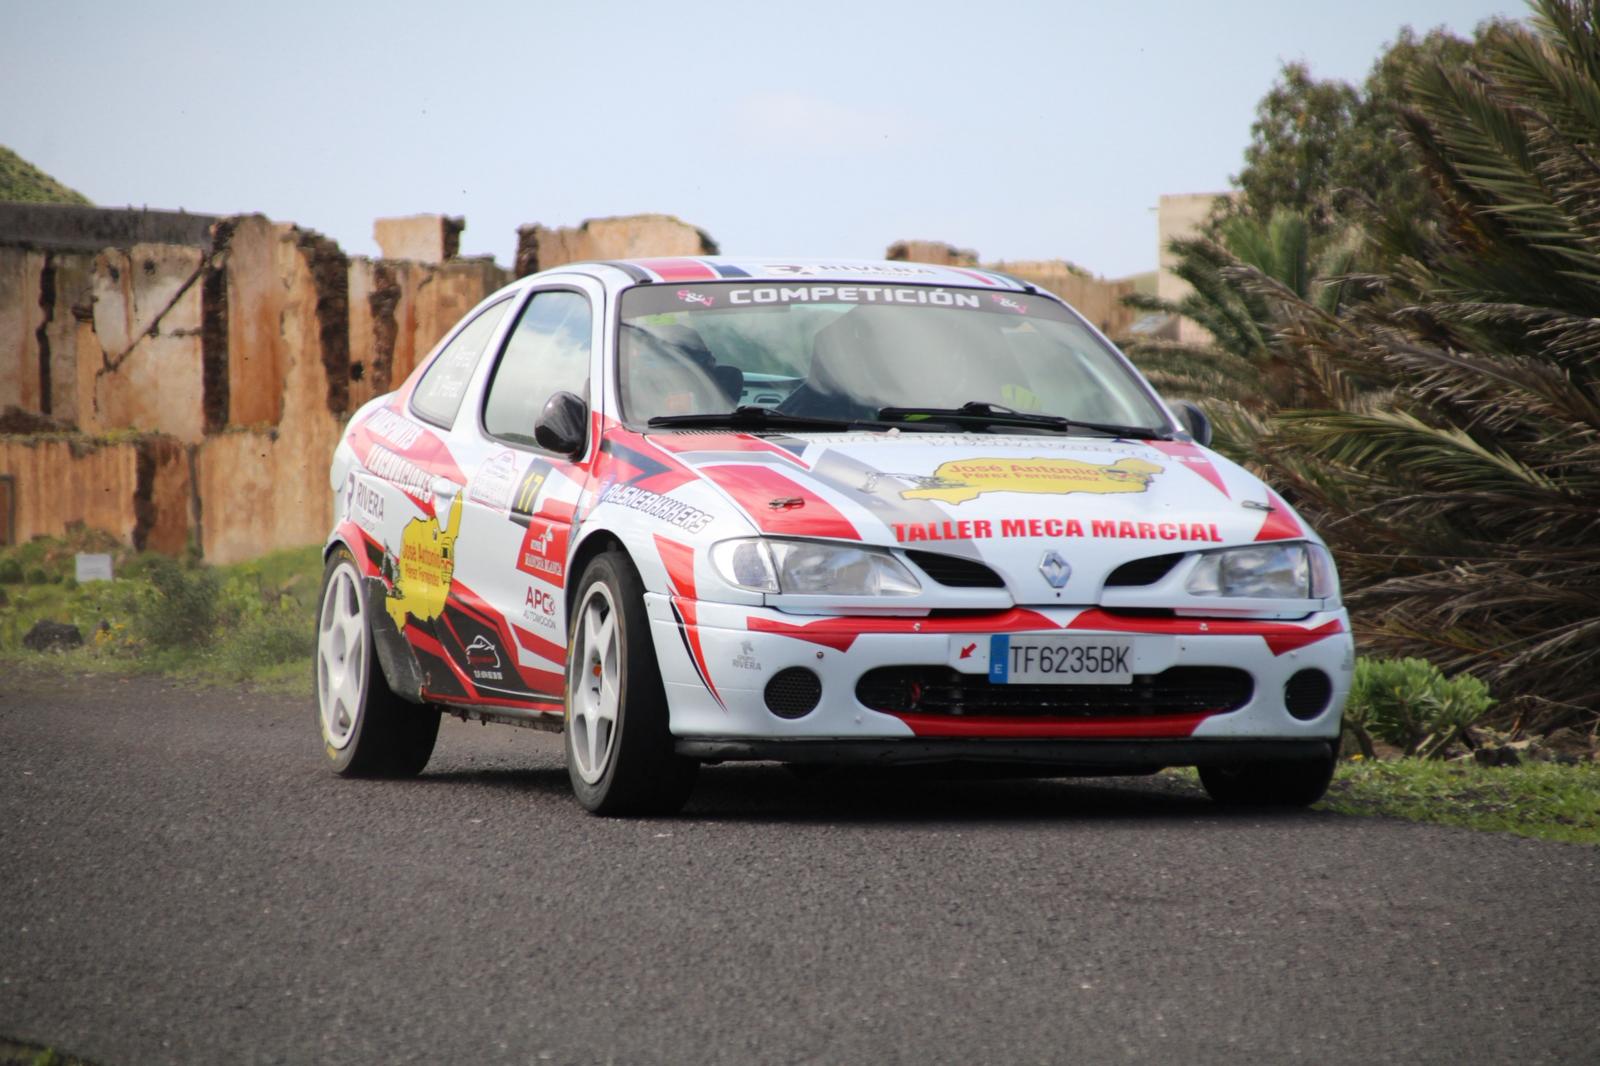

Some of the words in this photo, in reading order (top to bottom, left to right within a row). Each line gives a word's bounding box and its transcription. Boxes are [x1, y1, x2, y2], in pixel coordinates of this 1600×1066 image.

[729, 286, 980, 308] COMPETICIÓN
[950, 463, 1003, 474] José
[1010, 463, 1099, 476] Antonio
[356, 482, 384, 520] RIVERA
[518, 471, 545, 512] 17
[891, 519, 992, 542] TALLER
[1000, 518, 1084, 538] MECA
[1091, 519, 1223, 542] MARCIAL
[732, 659, 762, 671] RIVERA
[994, 664, 1003, 674] E
[1010, 646, 1130, 673] TF6235BK
